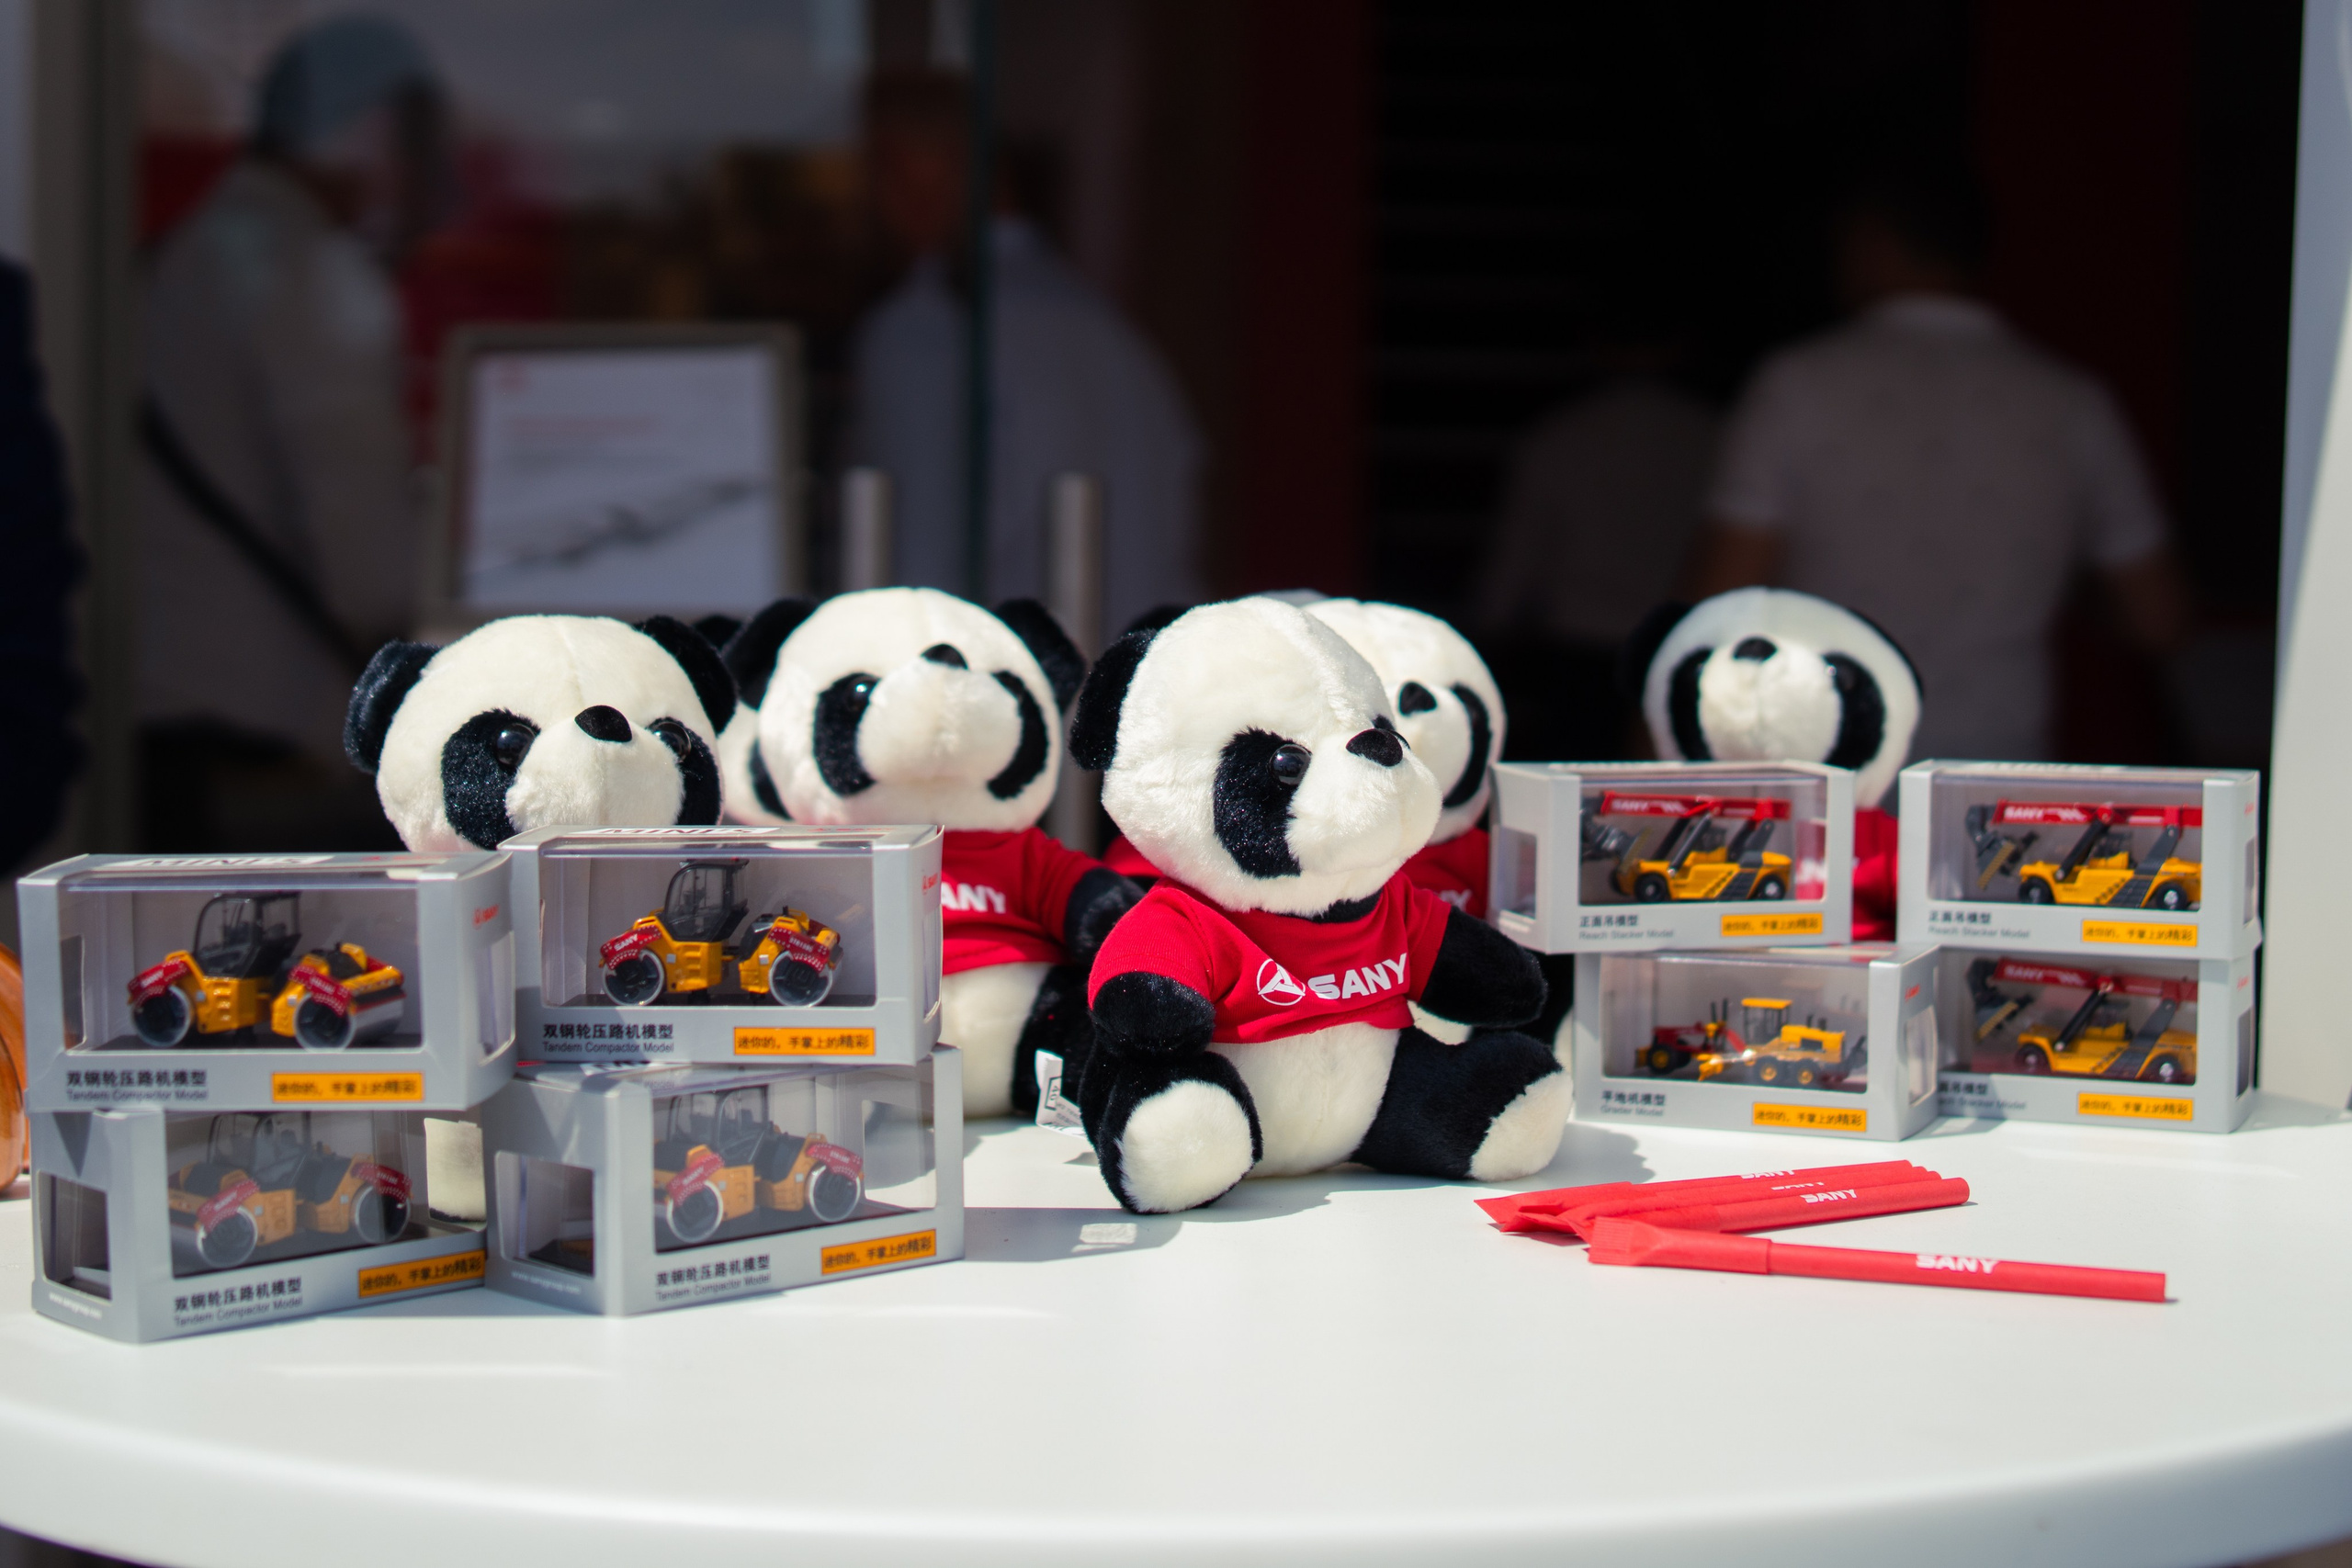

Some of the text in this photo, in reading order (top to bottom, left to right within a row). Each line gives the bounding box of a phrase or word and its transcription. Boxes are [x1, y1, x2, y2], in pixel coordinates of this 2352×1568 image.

[613, 933, 639, 952] SANY
[1307, 953, 1407, 1000] SANY
[543, 1023, 673, 1039] 双钢轮压路机模型
[542, 1041, 674, 1055] Tandem Compactor Model
[1801, 1189, 1858, 1204] SANY
[1916, 1254, 1997, 1274] SANY
